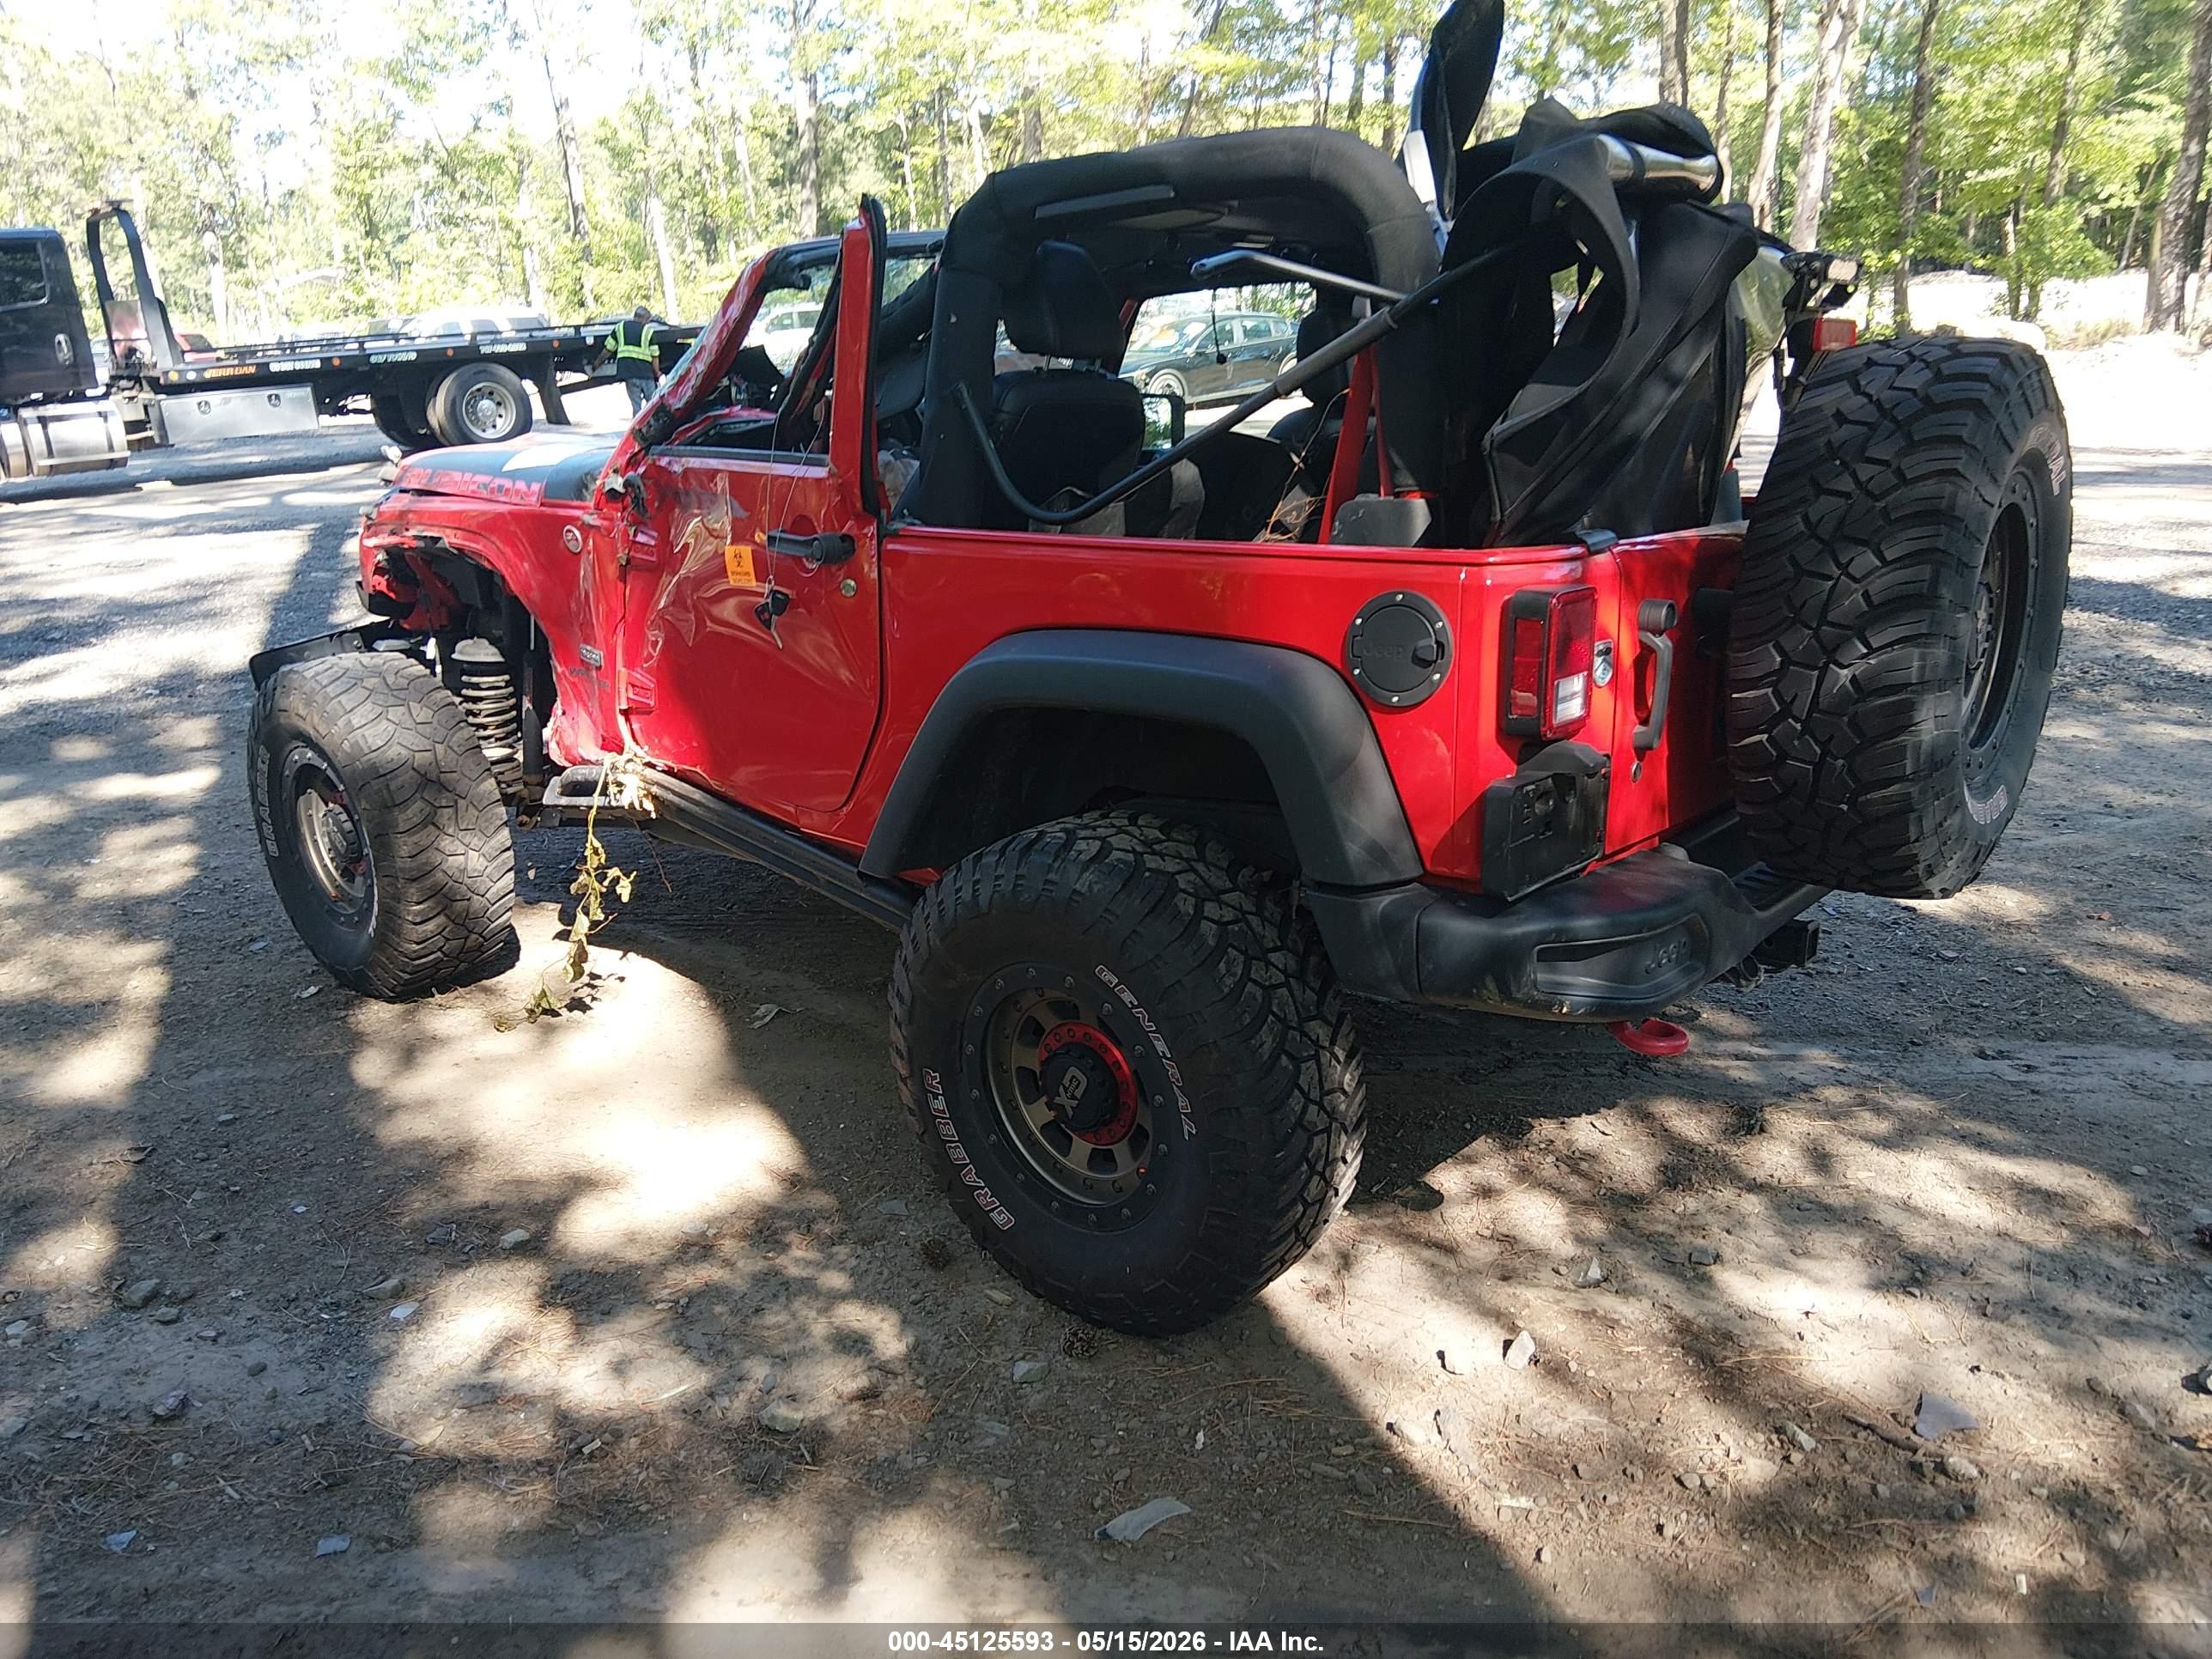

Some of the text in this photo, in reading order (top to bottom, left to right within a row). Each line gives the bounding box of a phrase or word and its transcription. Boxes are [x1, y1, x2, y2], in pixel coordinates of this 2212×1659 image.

[402, 465, 543, 505] RUBICON
[1095, 964, 1197, 1141] GENERAL
[922, 1068, 1016, 1231] GRABBER
